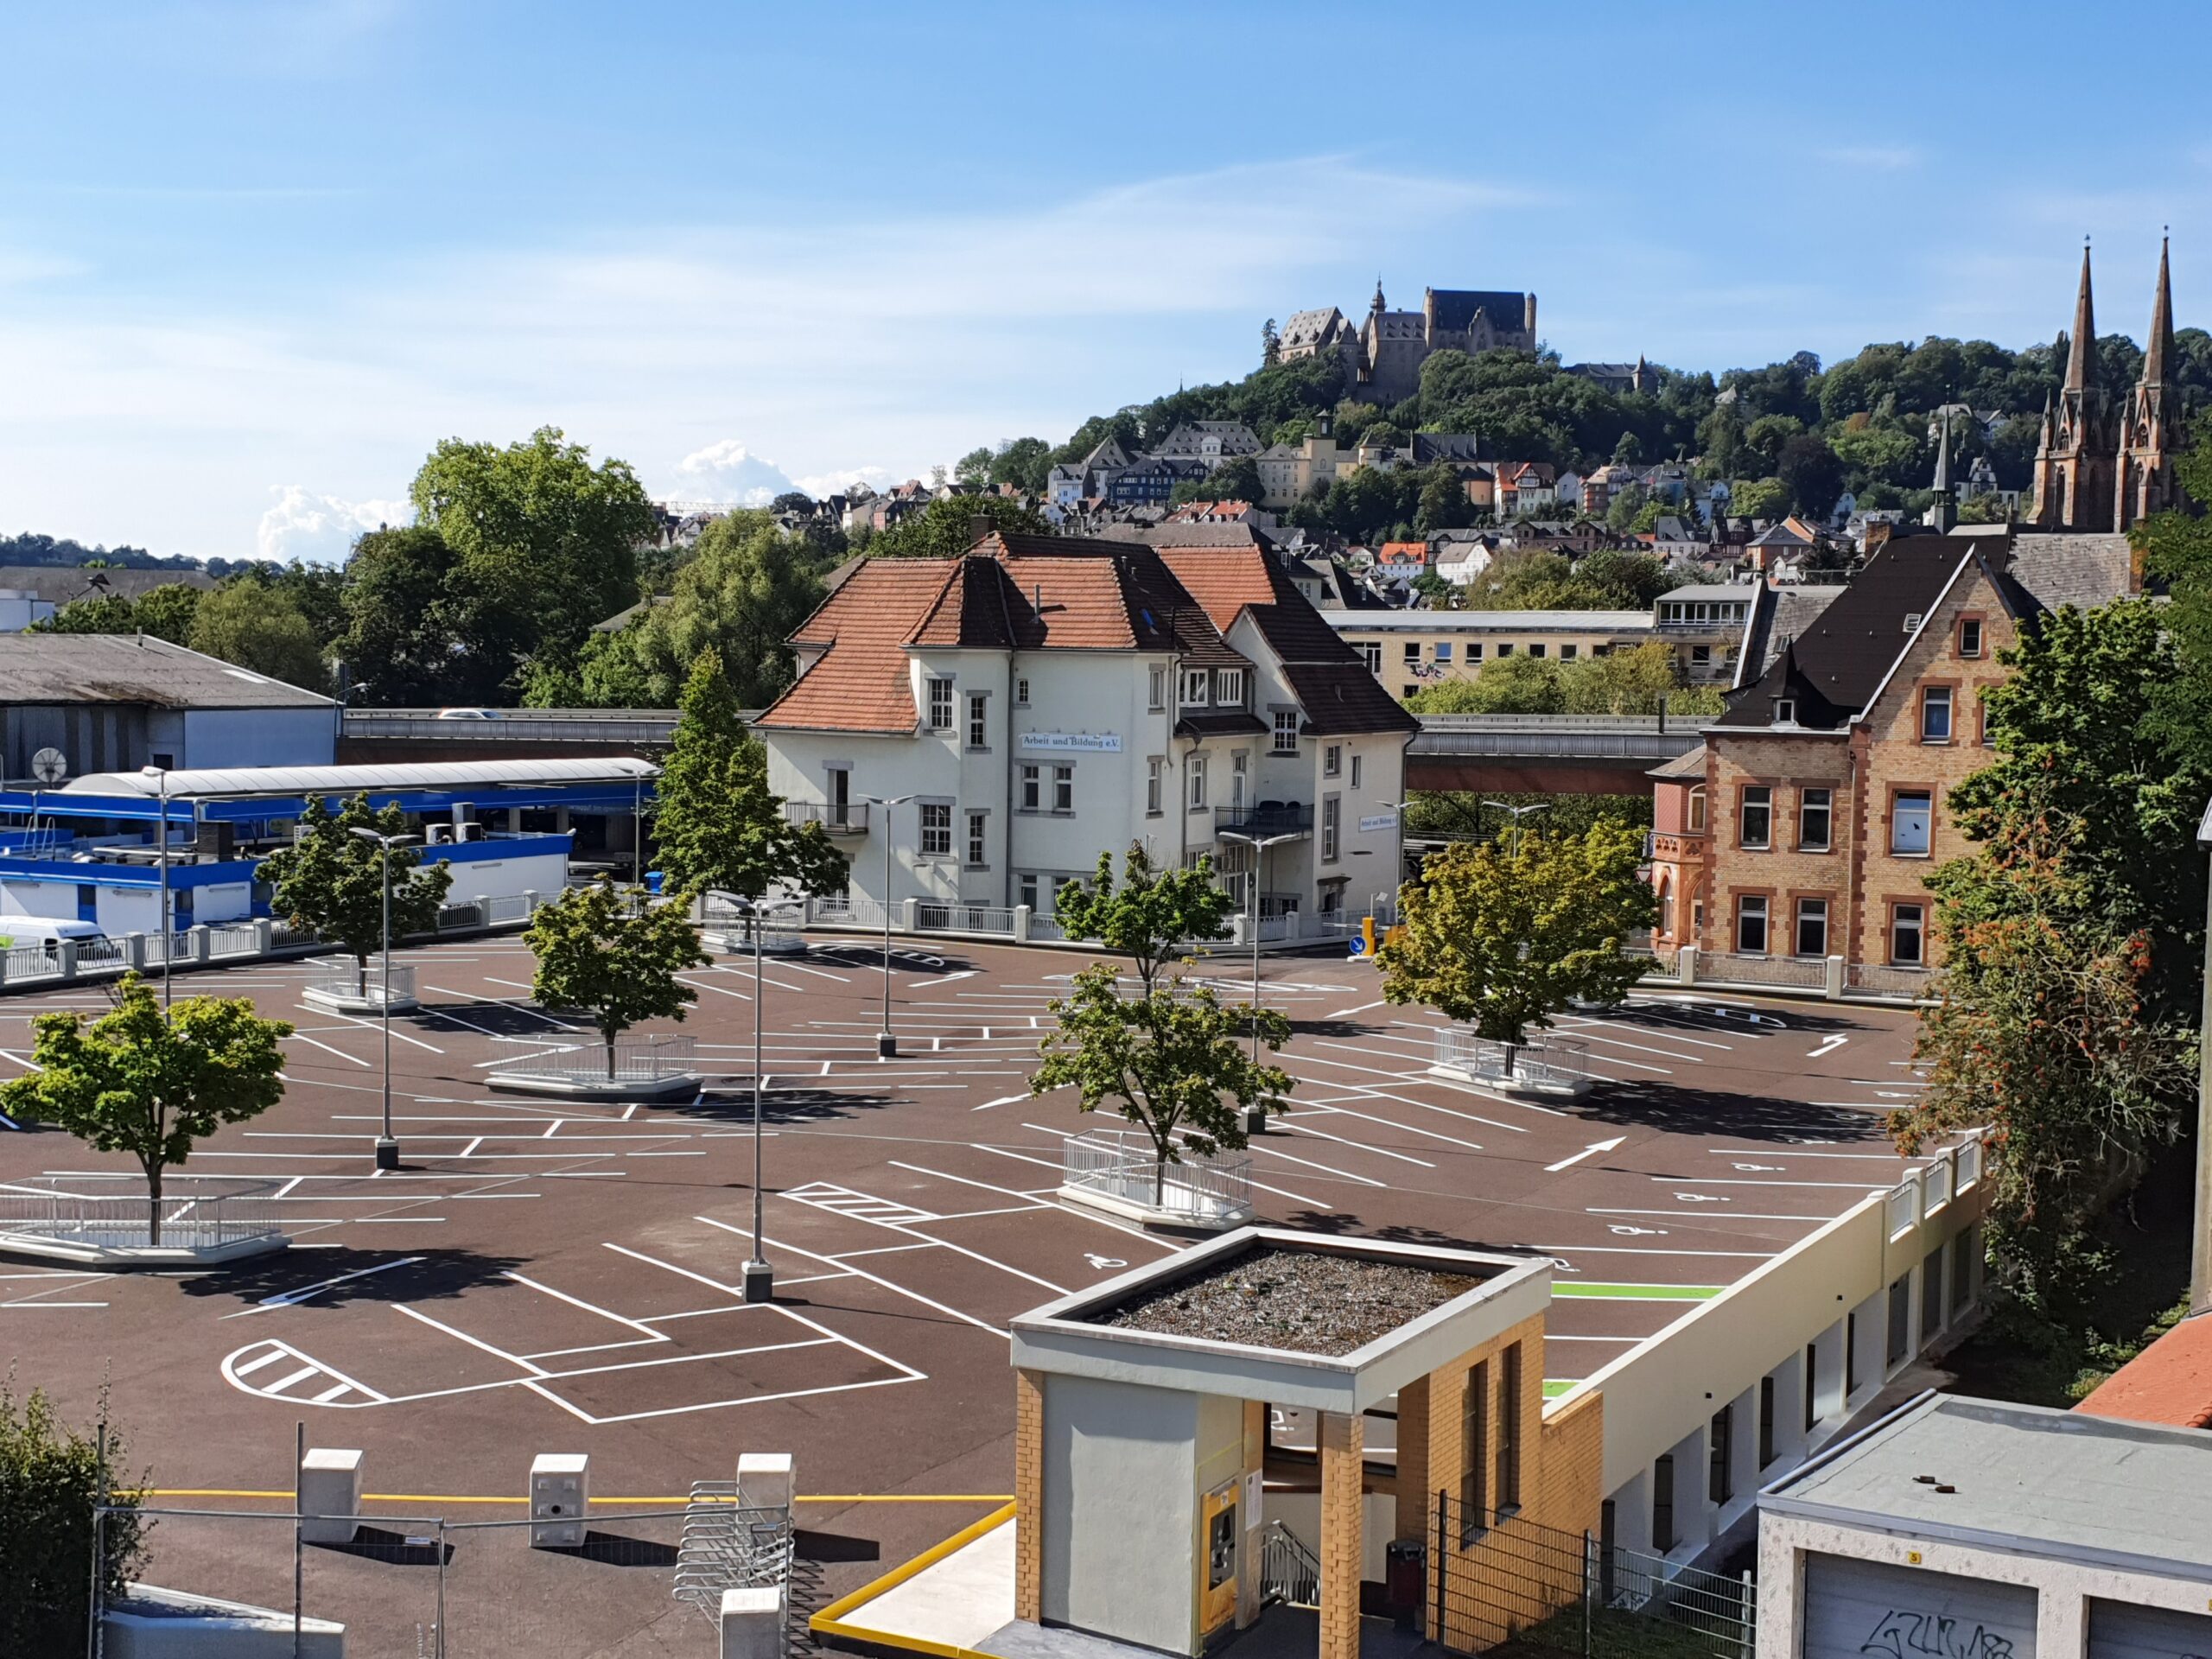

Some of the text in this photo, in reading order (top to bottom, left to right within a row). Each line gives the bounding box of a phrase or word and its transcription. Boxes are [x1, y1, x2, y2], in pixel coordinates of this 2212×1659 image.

[1023, 735, 1120, 748] Arbeit und Bildung e.V.
